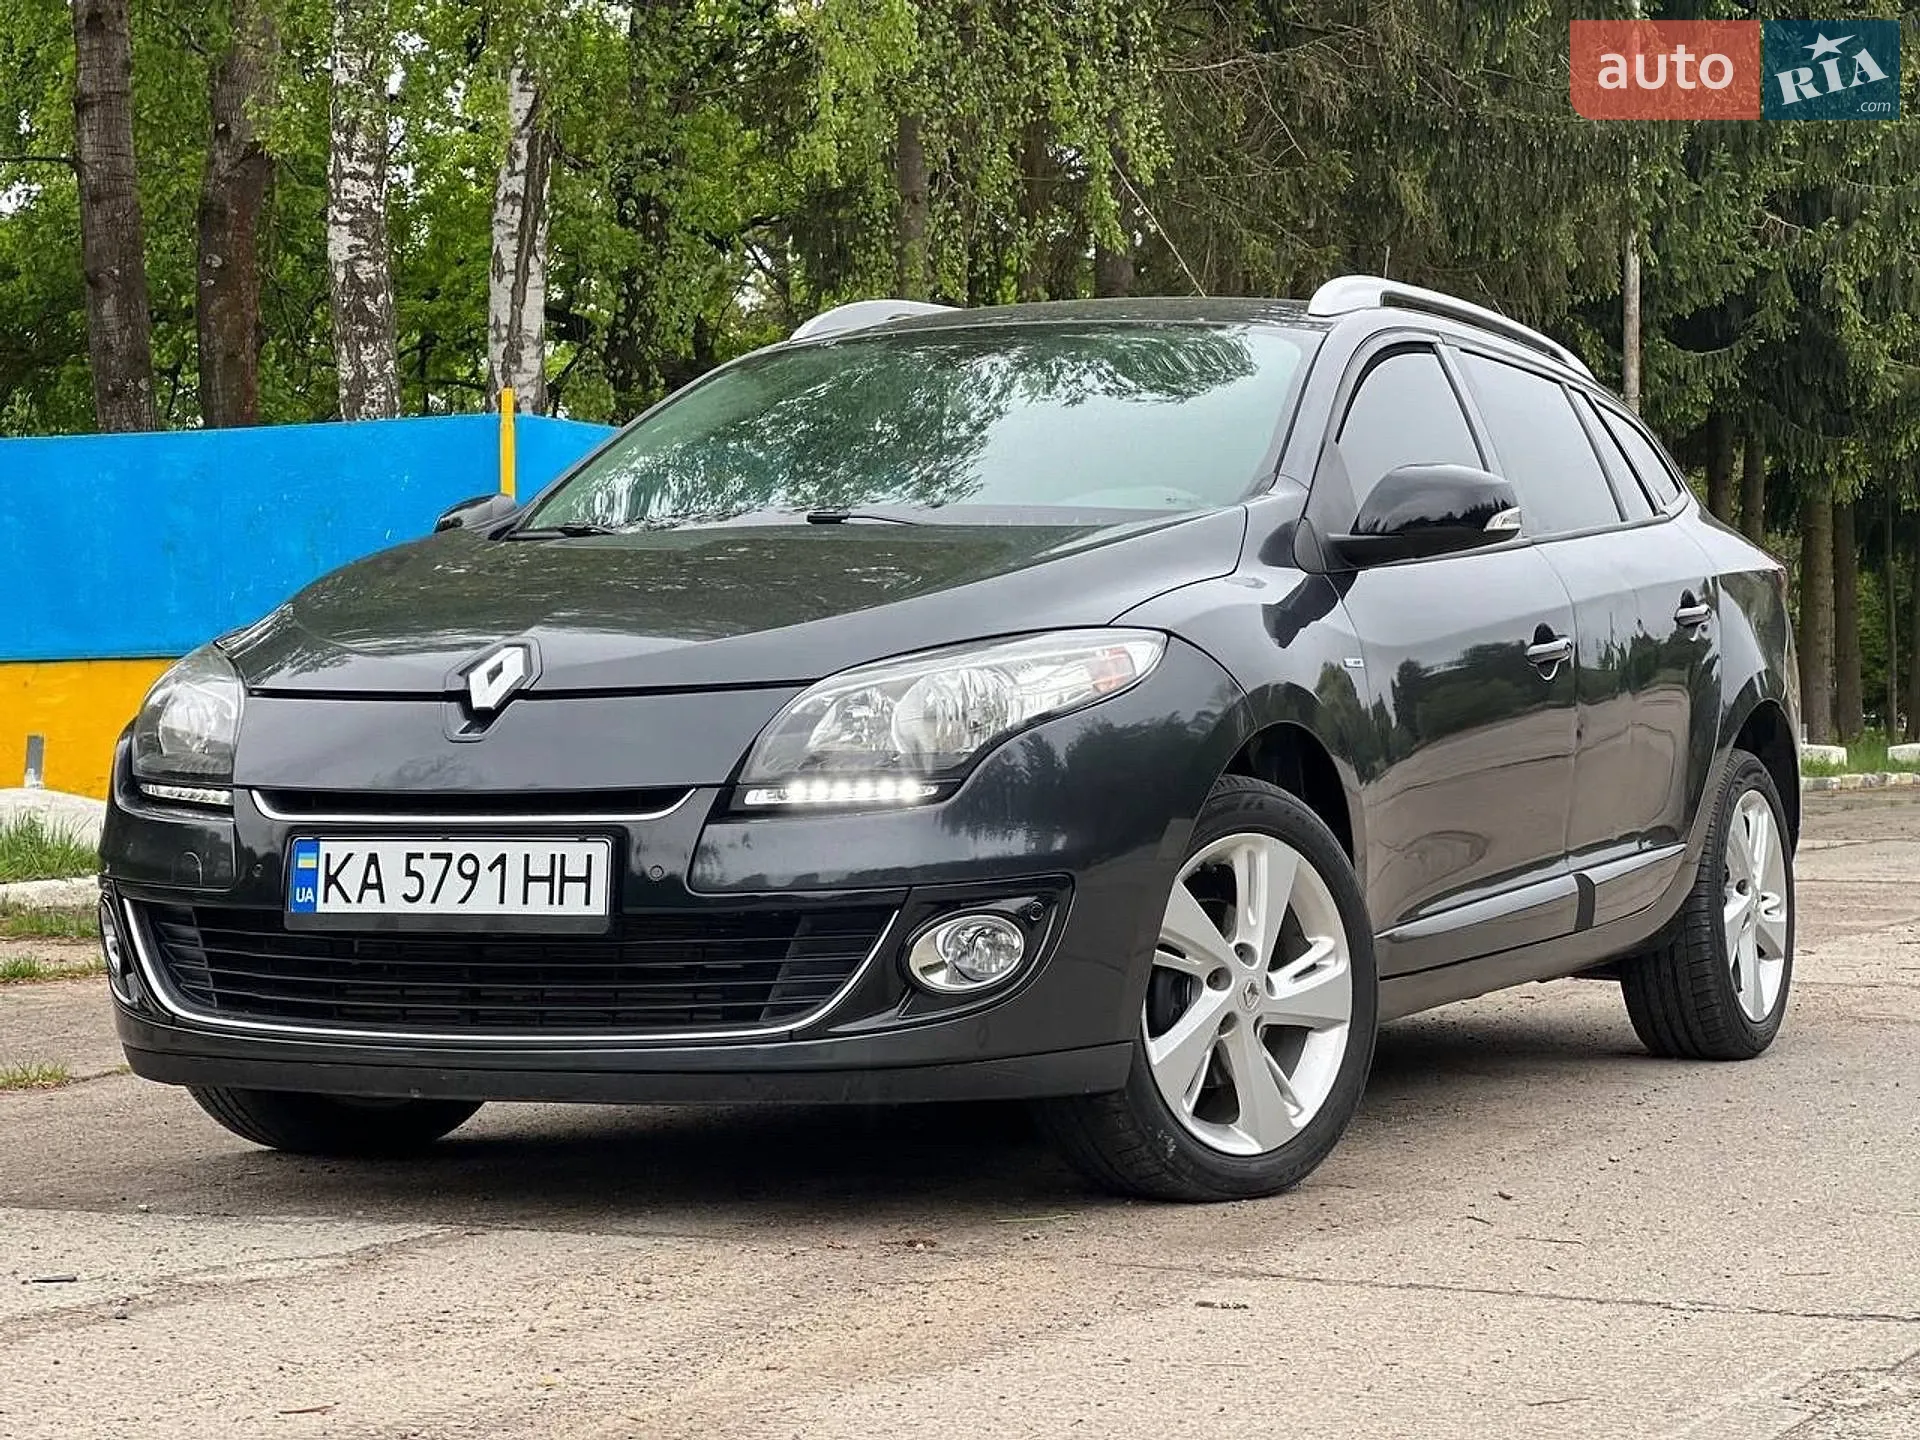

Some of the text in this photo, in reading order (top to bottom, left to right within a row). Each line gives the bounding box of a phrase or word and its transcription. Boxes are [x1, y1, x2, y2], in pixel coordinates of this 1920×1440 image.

[295, 887, 315, 903] UA
[322, 852, 593, 906] KA 5791 HH
